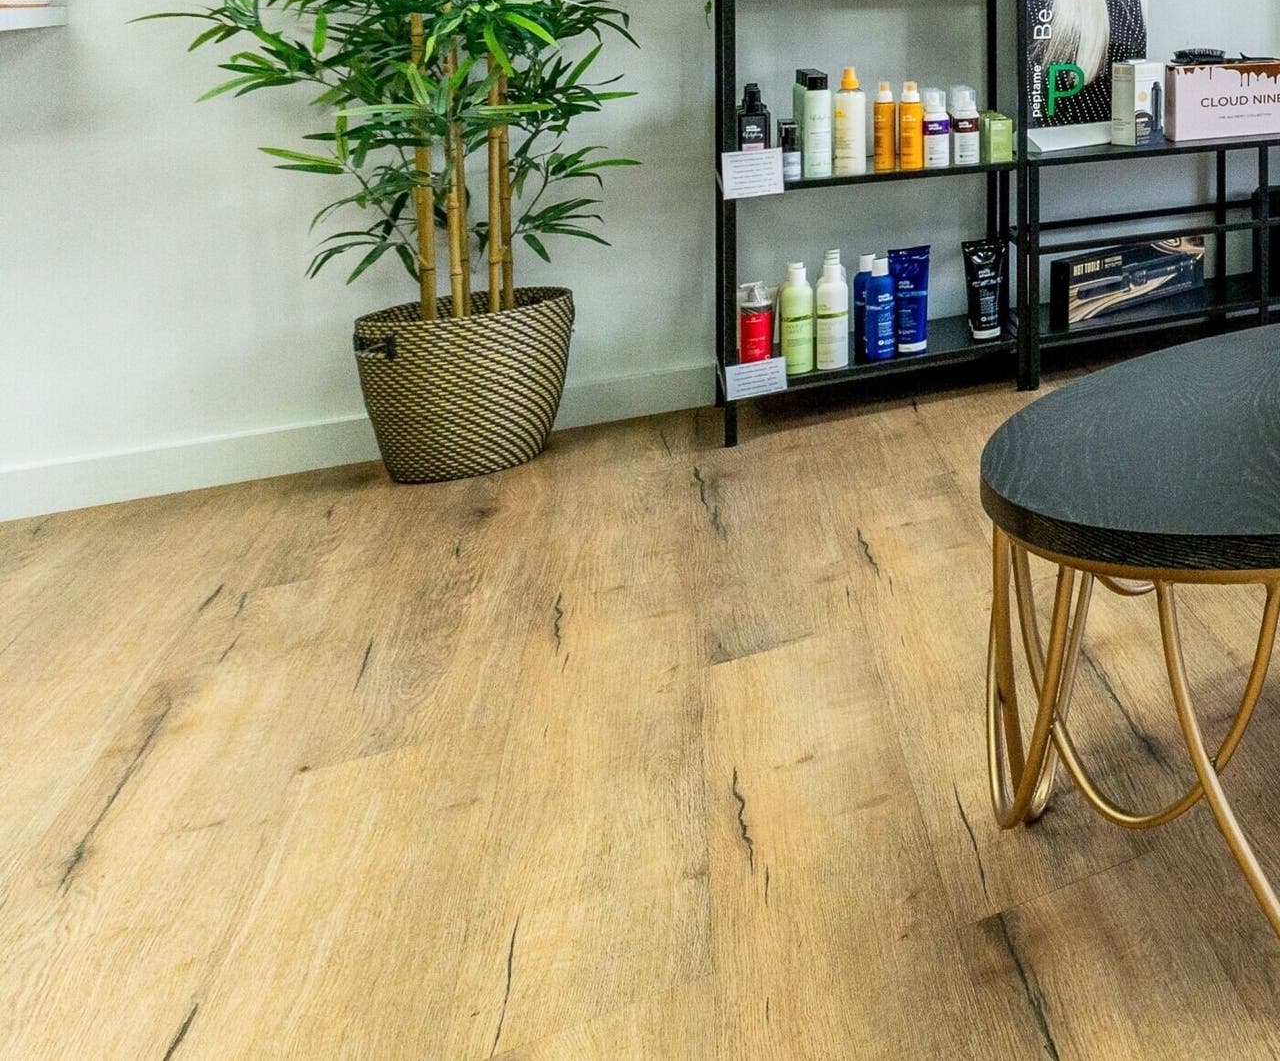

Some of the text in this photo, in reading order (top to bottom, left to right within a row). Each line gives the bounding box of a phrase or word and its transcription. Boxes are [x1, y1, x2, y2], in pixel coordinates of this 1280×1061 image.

[1033, 9, 1053, 39] Be
[1032, 64, 1042, 118] peptame
[1200, 95, 1249, 108] CLOUD
